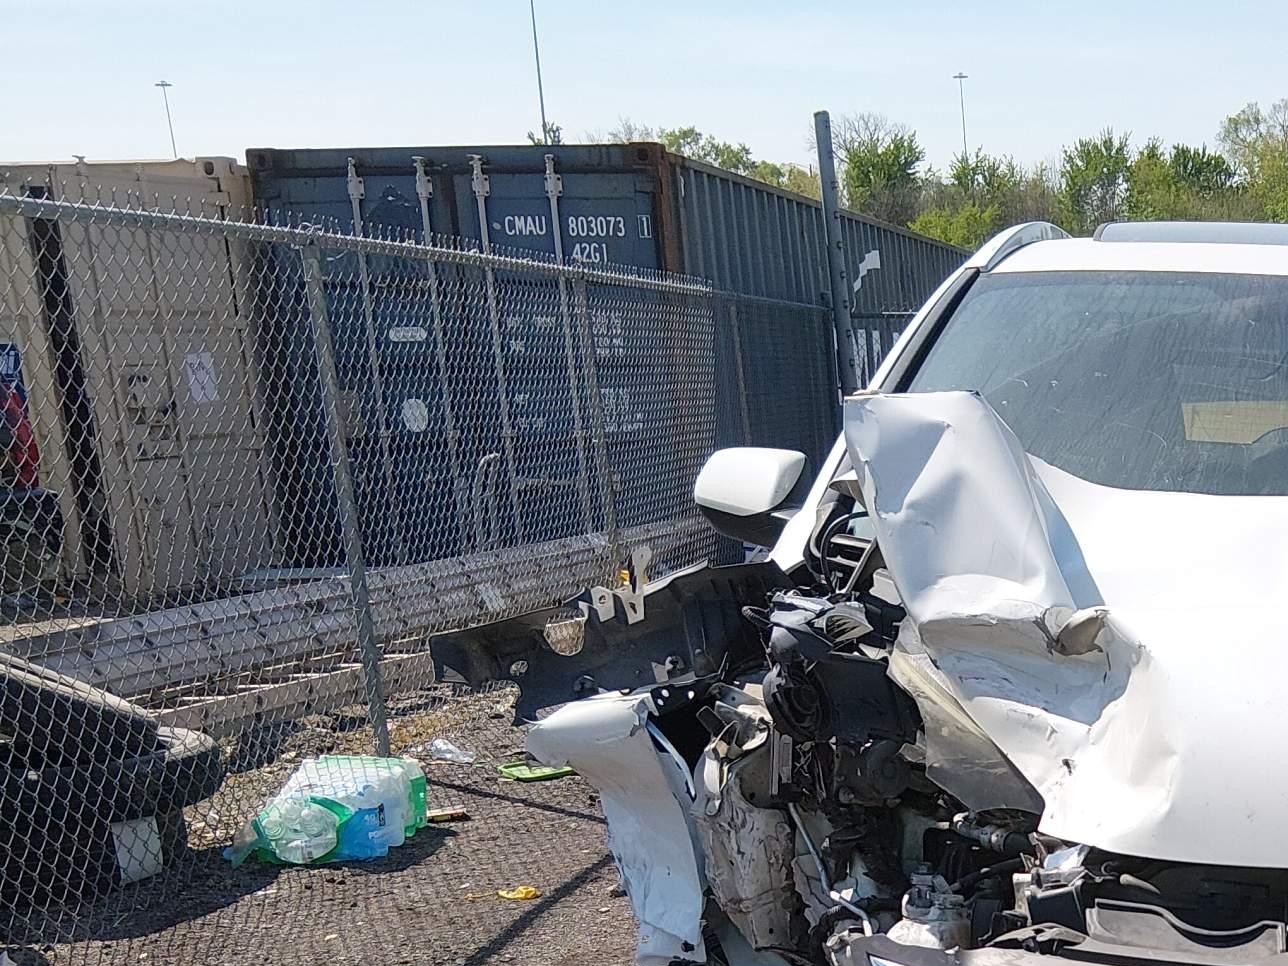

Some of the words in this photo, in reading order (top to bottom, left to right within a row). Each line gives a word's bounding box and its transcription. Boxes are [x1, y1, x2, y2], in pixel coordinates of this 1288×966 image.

[504, 215, 546, 236] CMAU
[568, 216, 626, 237] 803073
[572, 243, 608, 263] 42G1
